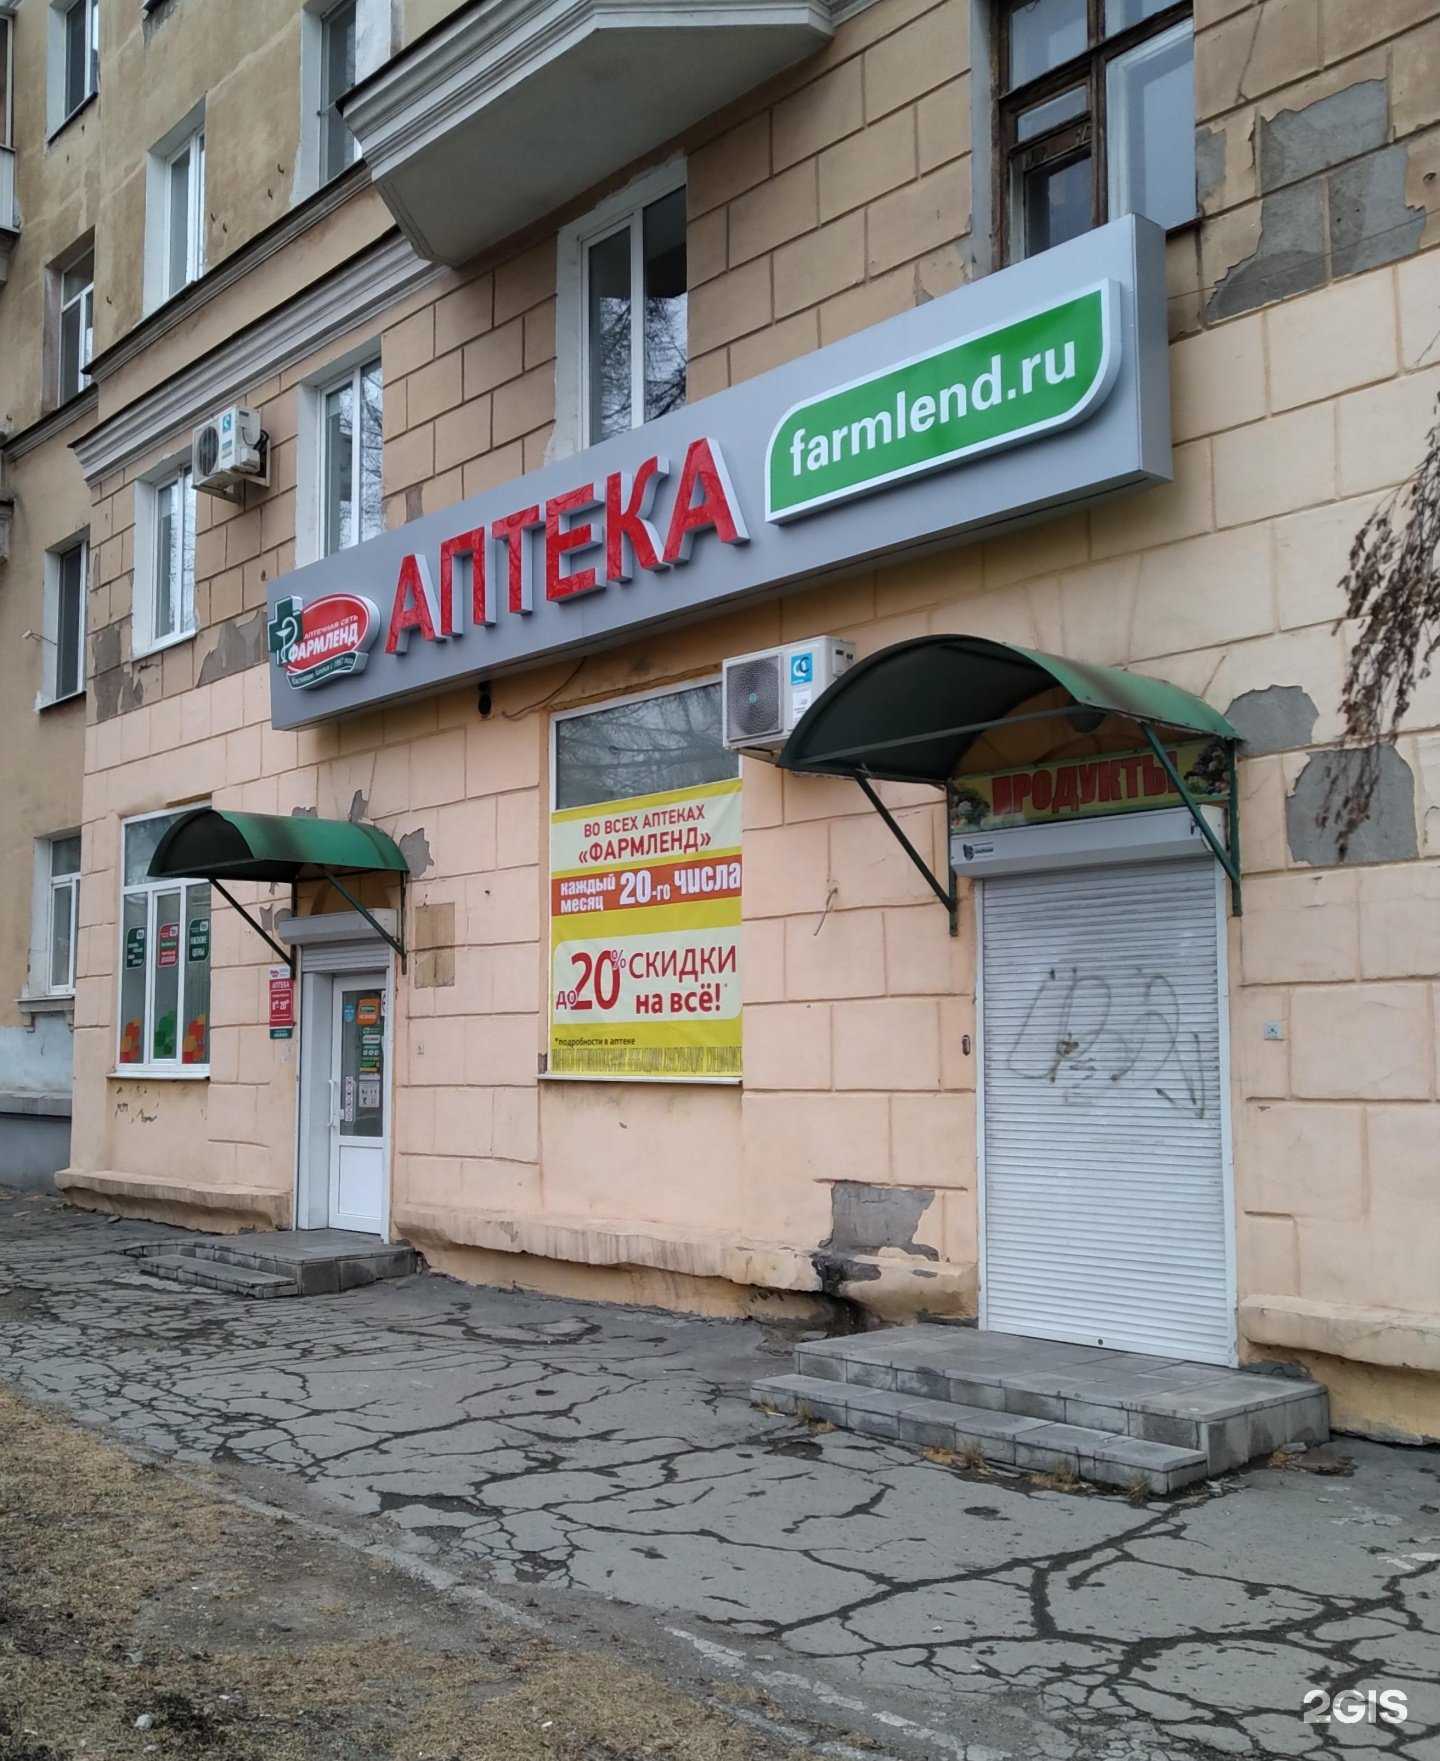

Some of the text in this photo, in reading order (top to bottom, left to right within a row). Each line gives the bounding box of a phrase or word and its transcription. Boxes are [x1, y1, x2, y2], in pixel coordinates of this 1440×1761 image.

[790, 341, 1076, 477] farmlend.ru
[385, 436, 748, 655] АПТЕКА
[288, 622, 359, 662] ФАРМЛЕНД
[991, 751, 1179, 815] ПРОДУКТЫ
[584, 804, 706, 838] ВО ВСЕХ АПТЕКАХ
[578, 826, 712, 864] «ФАРМЛЕНД»
[560, 874, 616, 896] каждый
[674, 862, 741, 895] числа
[560, 896, 604, 913] месяц
[629, 945, 736, 983] СКИДКИ
[556, 990, 577, 1010] до
[635, 992, 663, 1014] на
